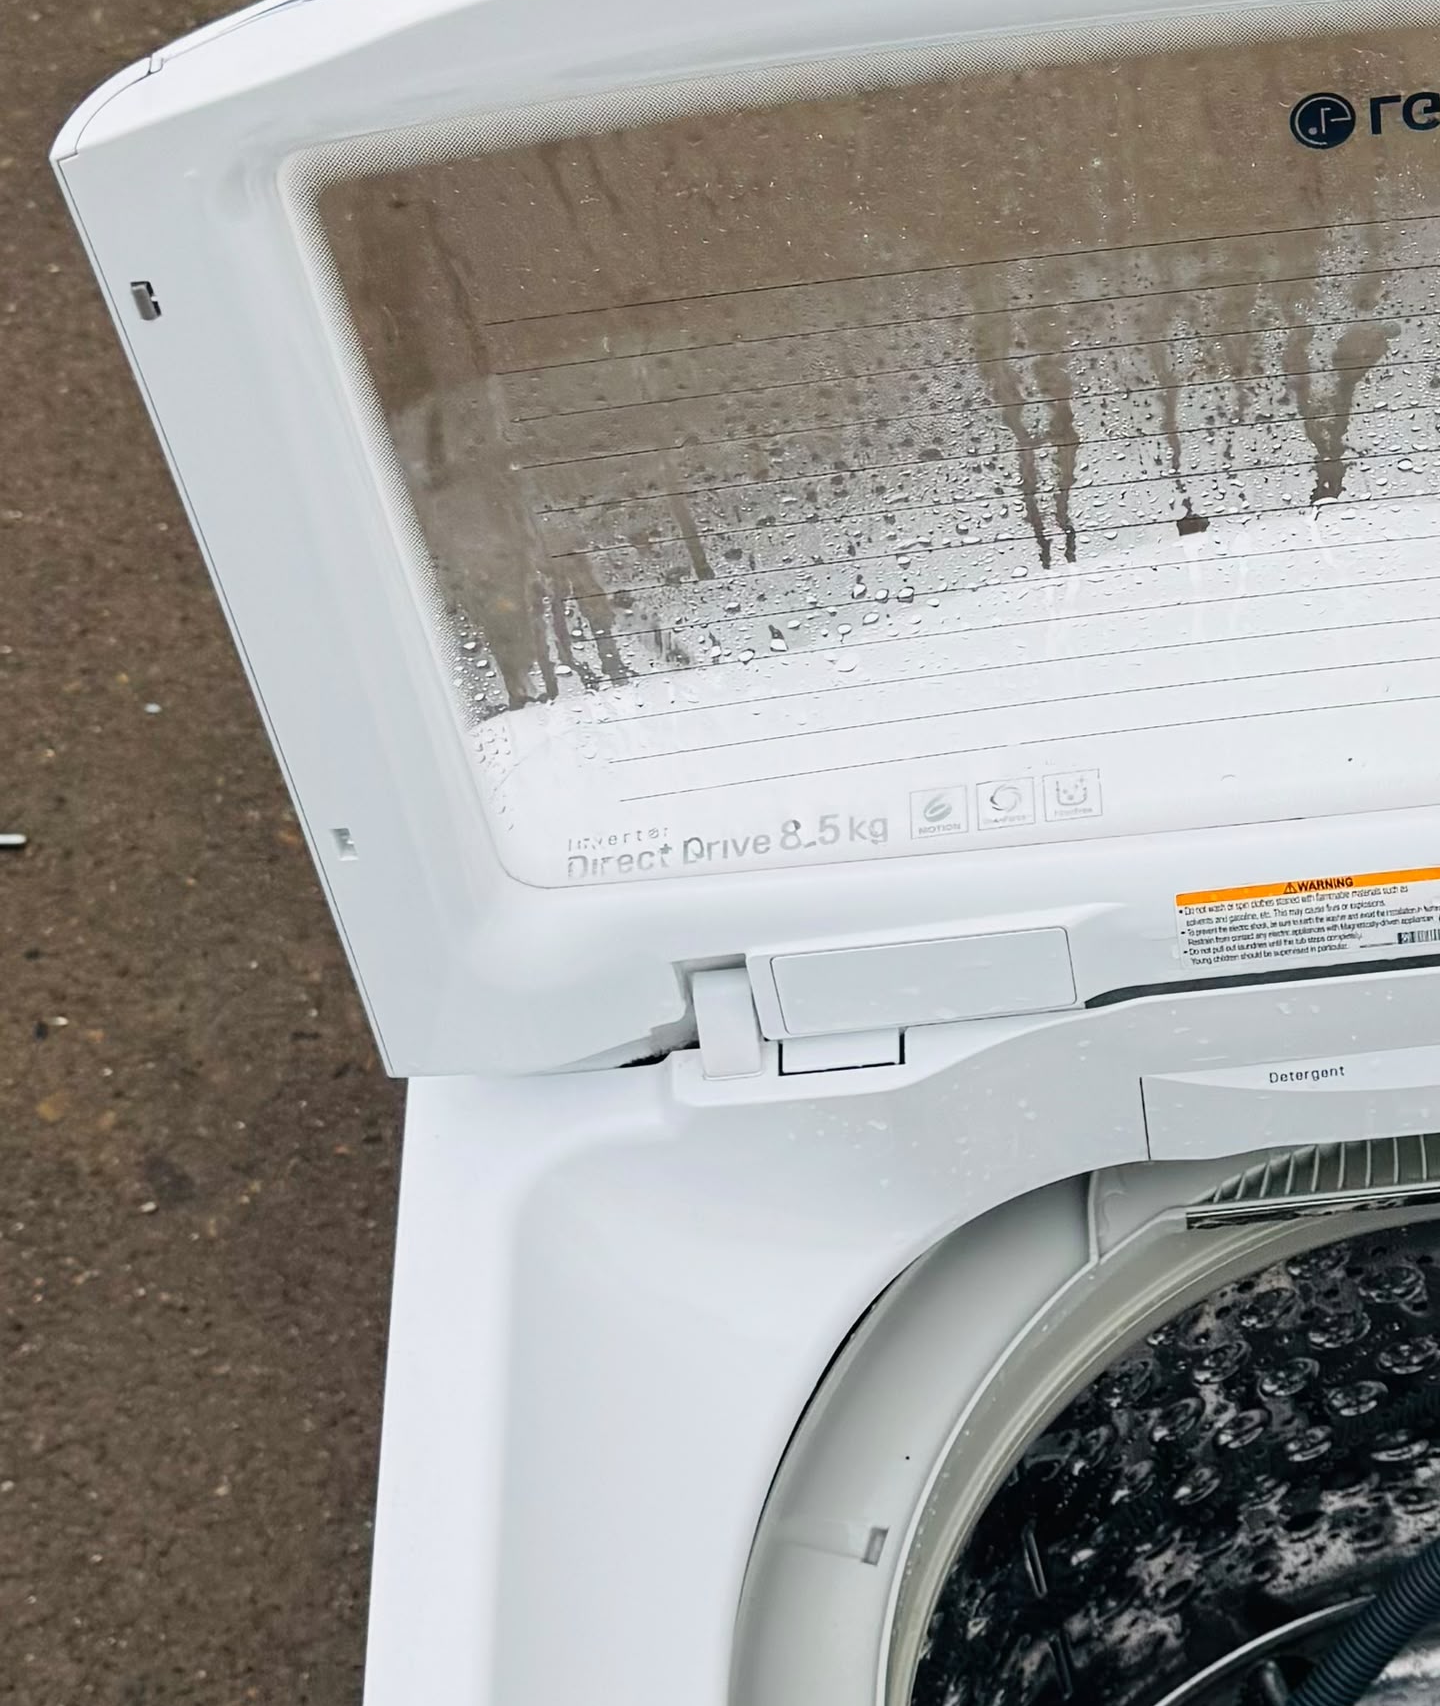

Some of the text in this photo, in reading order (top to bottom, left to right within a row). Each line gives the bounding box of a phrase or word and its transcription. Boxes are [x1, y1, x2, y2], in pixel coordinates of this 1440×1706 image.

[683, 833, 771, 865] Drive
[849, 815, 889, 844] kg
[1297, 876, 1354, 892] WARNING
[1269, 1065, 1345, 1084] Detergent
